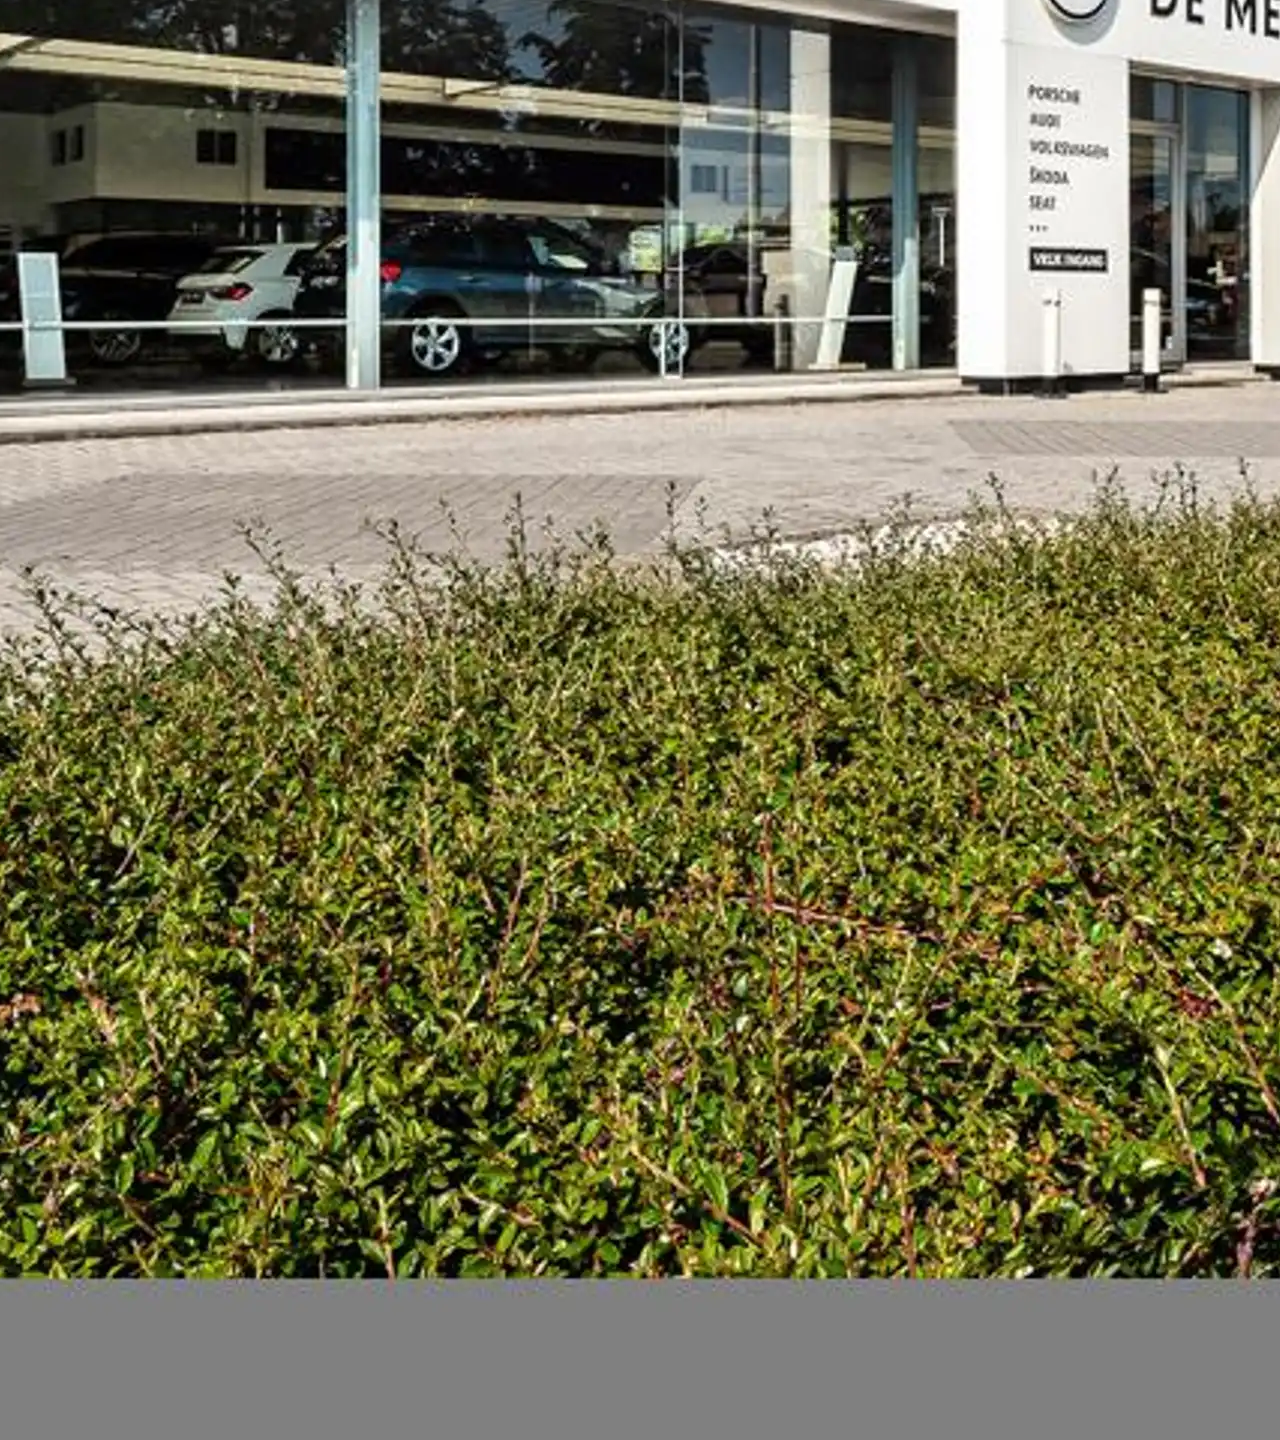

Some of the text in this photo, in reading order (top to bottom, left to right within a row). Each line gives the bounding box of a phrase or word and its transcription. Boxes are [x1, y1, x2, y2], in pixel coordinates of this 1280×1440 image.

[1028, 84, 1080, 105] PORSCHE
[1029, 113, 1061, 129] AUDI
[1029, 140, 1109, 159] VOLKSWAGEN
[1029, 194, 1056, 211] SEAT
